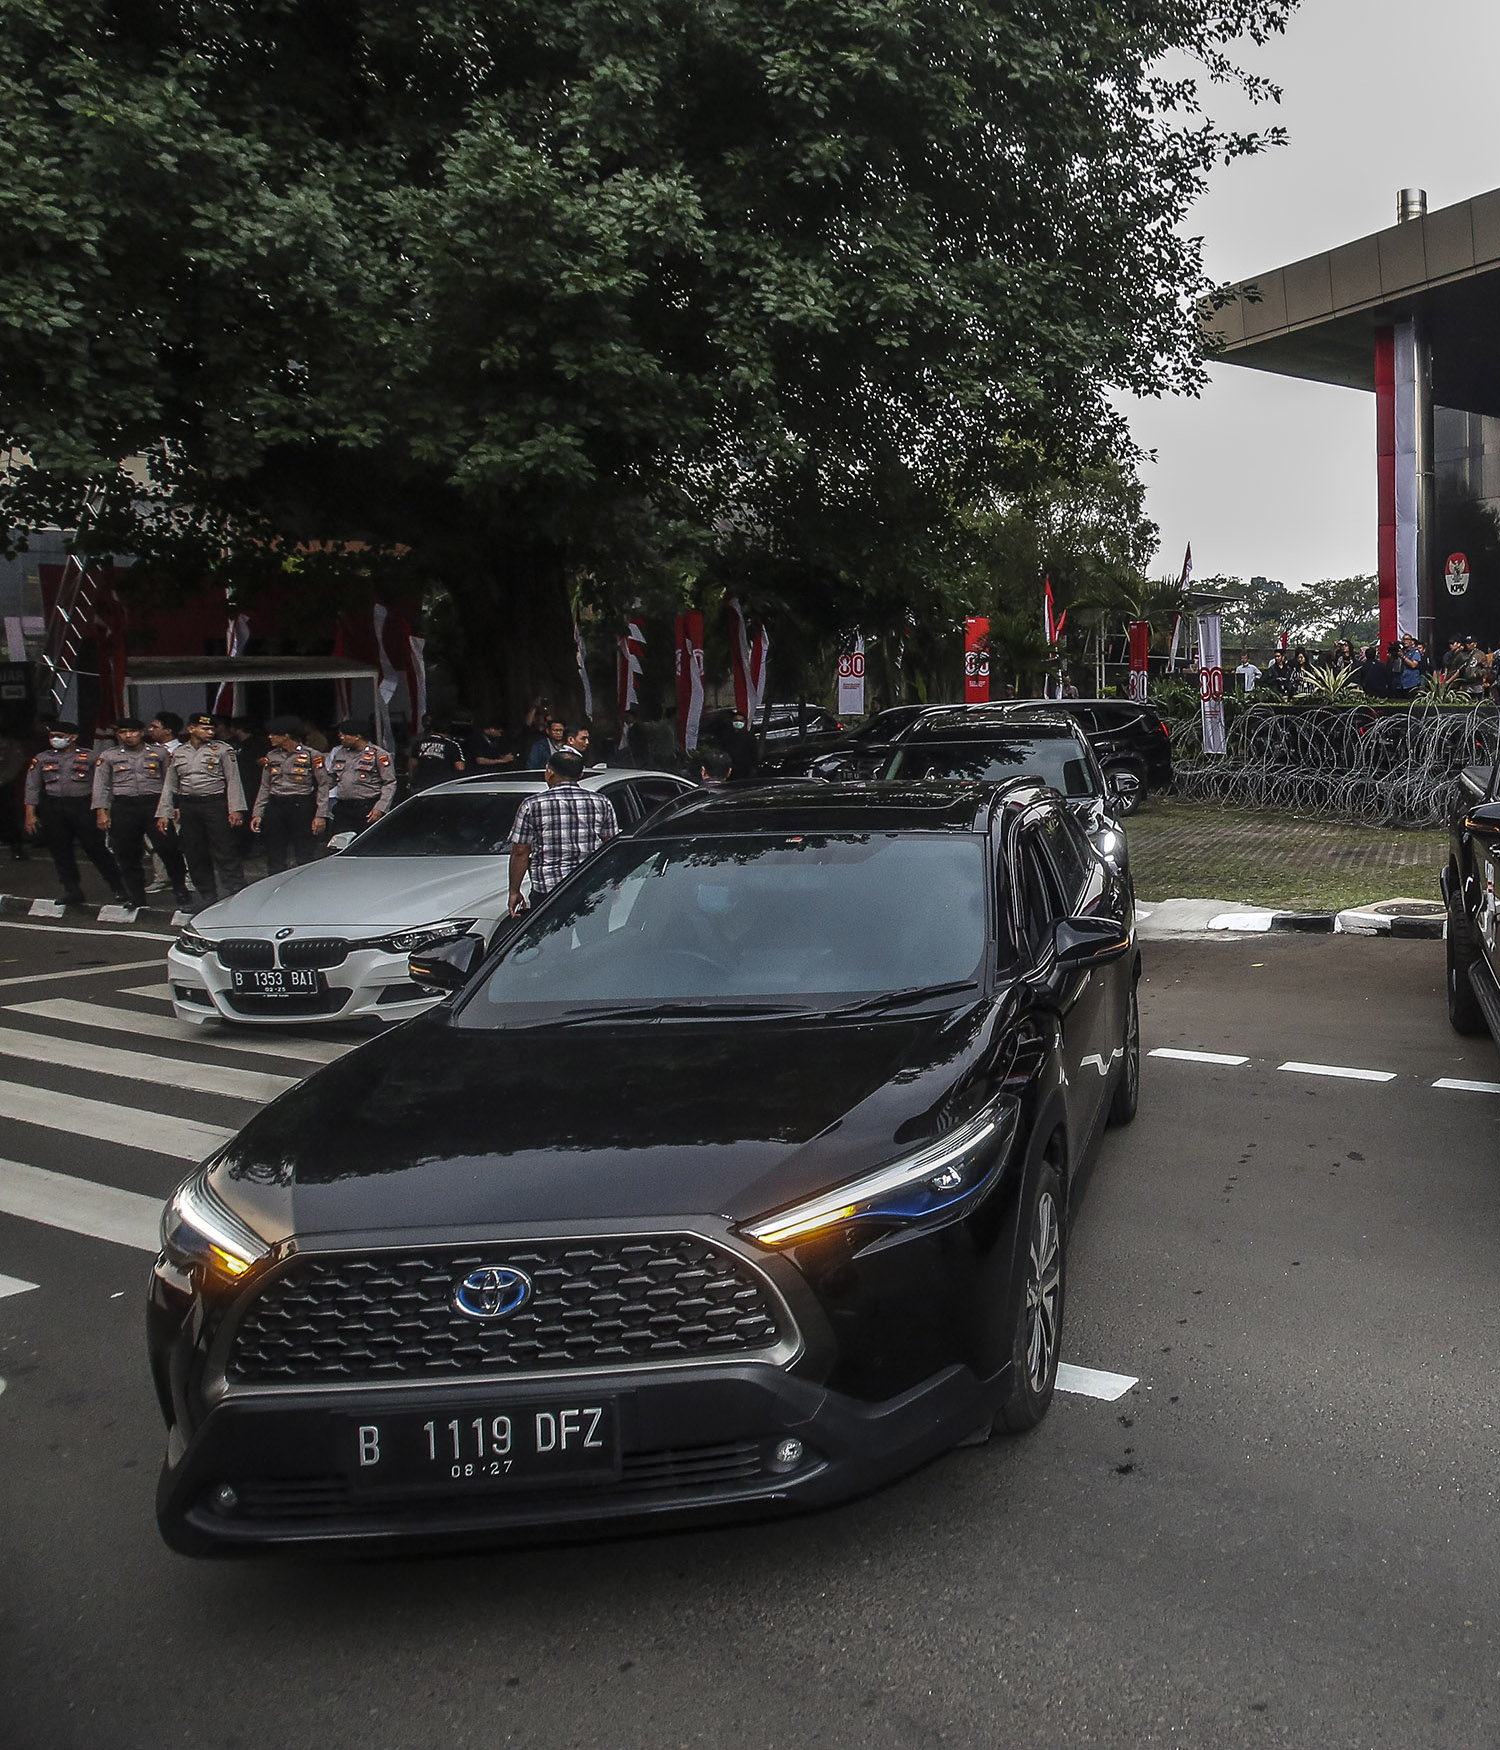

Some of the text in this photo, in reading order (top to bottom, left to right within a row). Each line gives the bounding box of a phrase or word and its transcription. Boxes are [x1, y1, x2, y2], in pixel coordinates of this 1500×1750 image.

[1451, 583, 1465, 592] KPK
[839, 652, 864, 677] 80
[1129, 670, 1147, 702] 80
[1200, 667, 1223, 702] 80
[235, 971, 313, 986] B 1353 BAI
[359, 1407, 603, 1466] B 1119 DFZ
